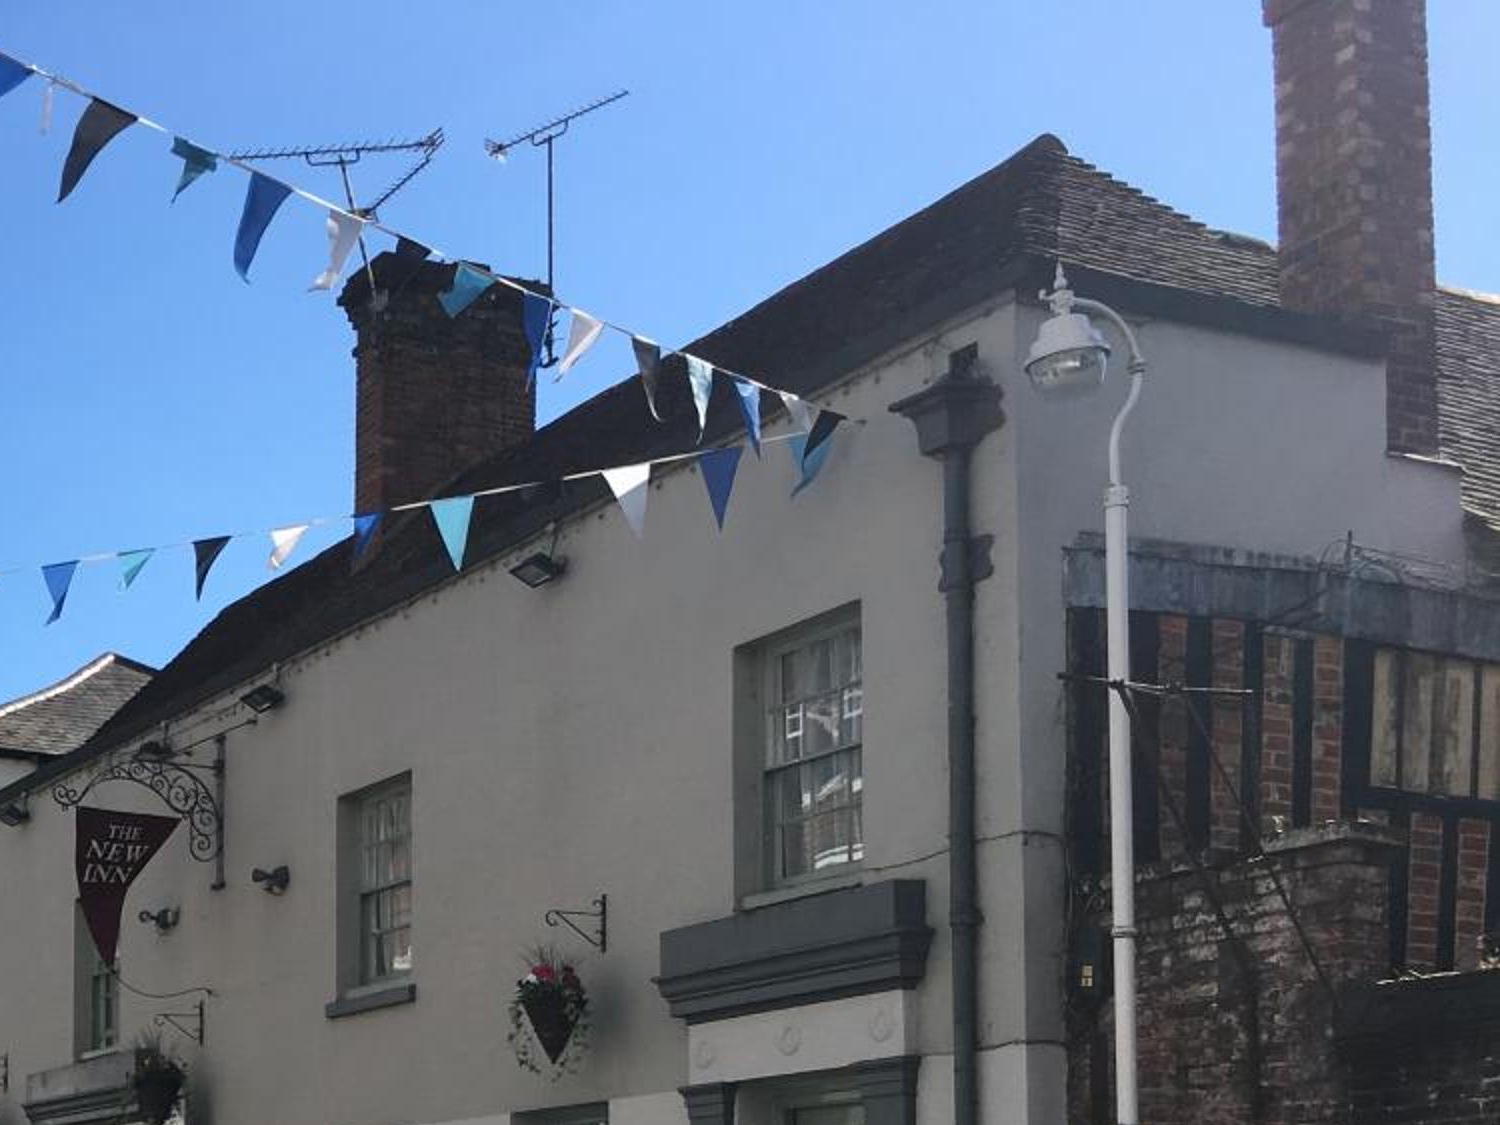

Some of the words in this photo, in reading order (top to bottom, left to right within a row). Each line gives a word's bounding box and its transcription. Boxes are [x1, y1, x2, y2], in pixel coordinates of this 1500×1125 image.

[109, 824, 143, 841] THE
[85, 839, 150, 862] NEW
[83, 863, 134, 884] INN
